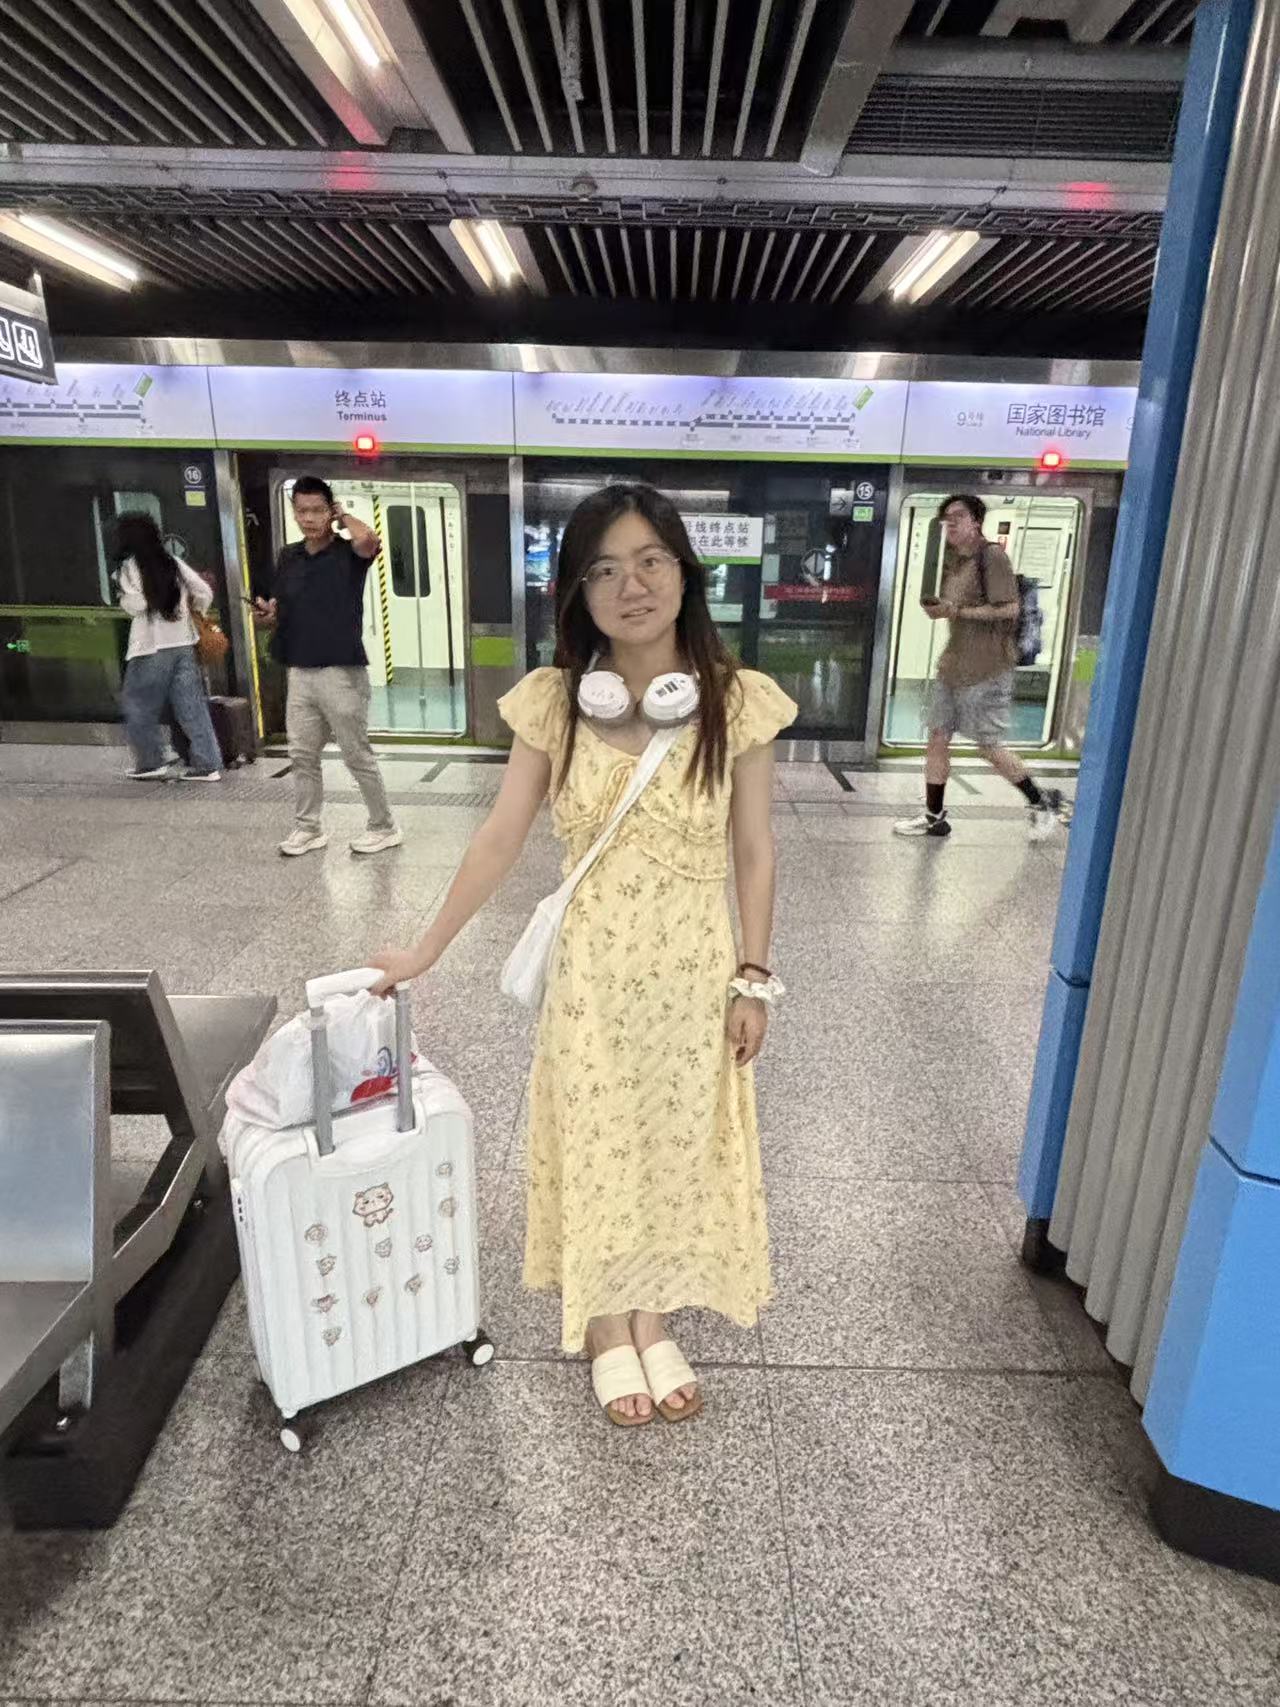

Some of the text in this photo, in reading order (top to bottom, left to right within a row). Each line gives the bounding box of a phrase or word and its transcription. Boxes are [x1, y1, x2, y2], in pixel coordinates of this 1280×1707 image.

[335, 389, 387, 408] 终点站
[336, 410, 388, 421] Terminus
[1006, 403, 1106, 427] 国家图书馆
[1016, 426, 1092, 440] National Library
